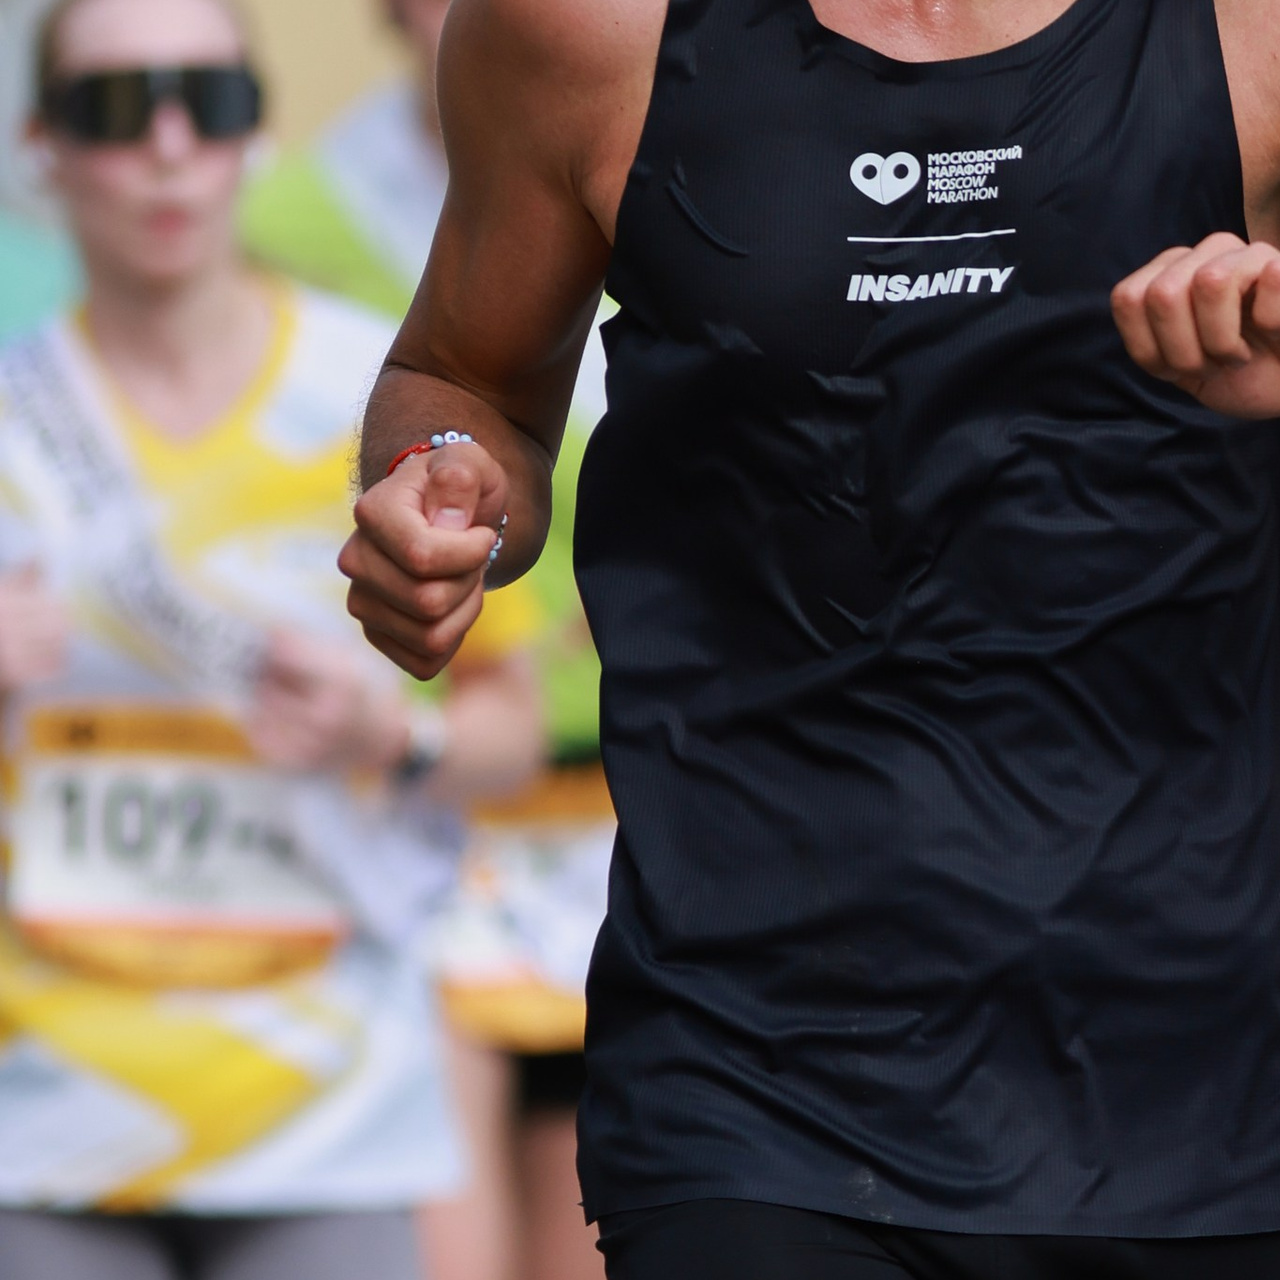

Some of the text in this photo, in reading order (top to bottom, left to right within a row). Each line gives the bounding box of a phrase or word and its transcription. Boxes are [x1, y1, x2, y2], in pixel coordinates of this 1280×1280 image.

[927, 145, 1022, 165] МОСКОВСКИЙ
[927, 162, 995, 178] МАРАФОН
[927, 175, 987, 191] MOSCOW
[927, 186, 998, 203] MARATHON
[847, 266, 1015, 302] INSANITY
[50, 778, 300, 866] 109
